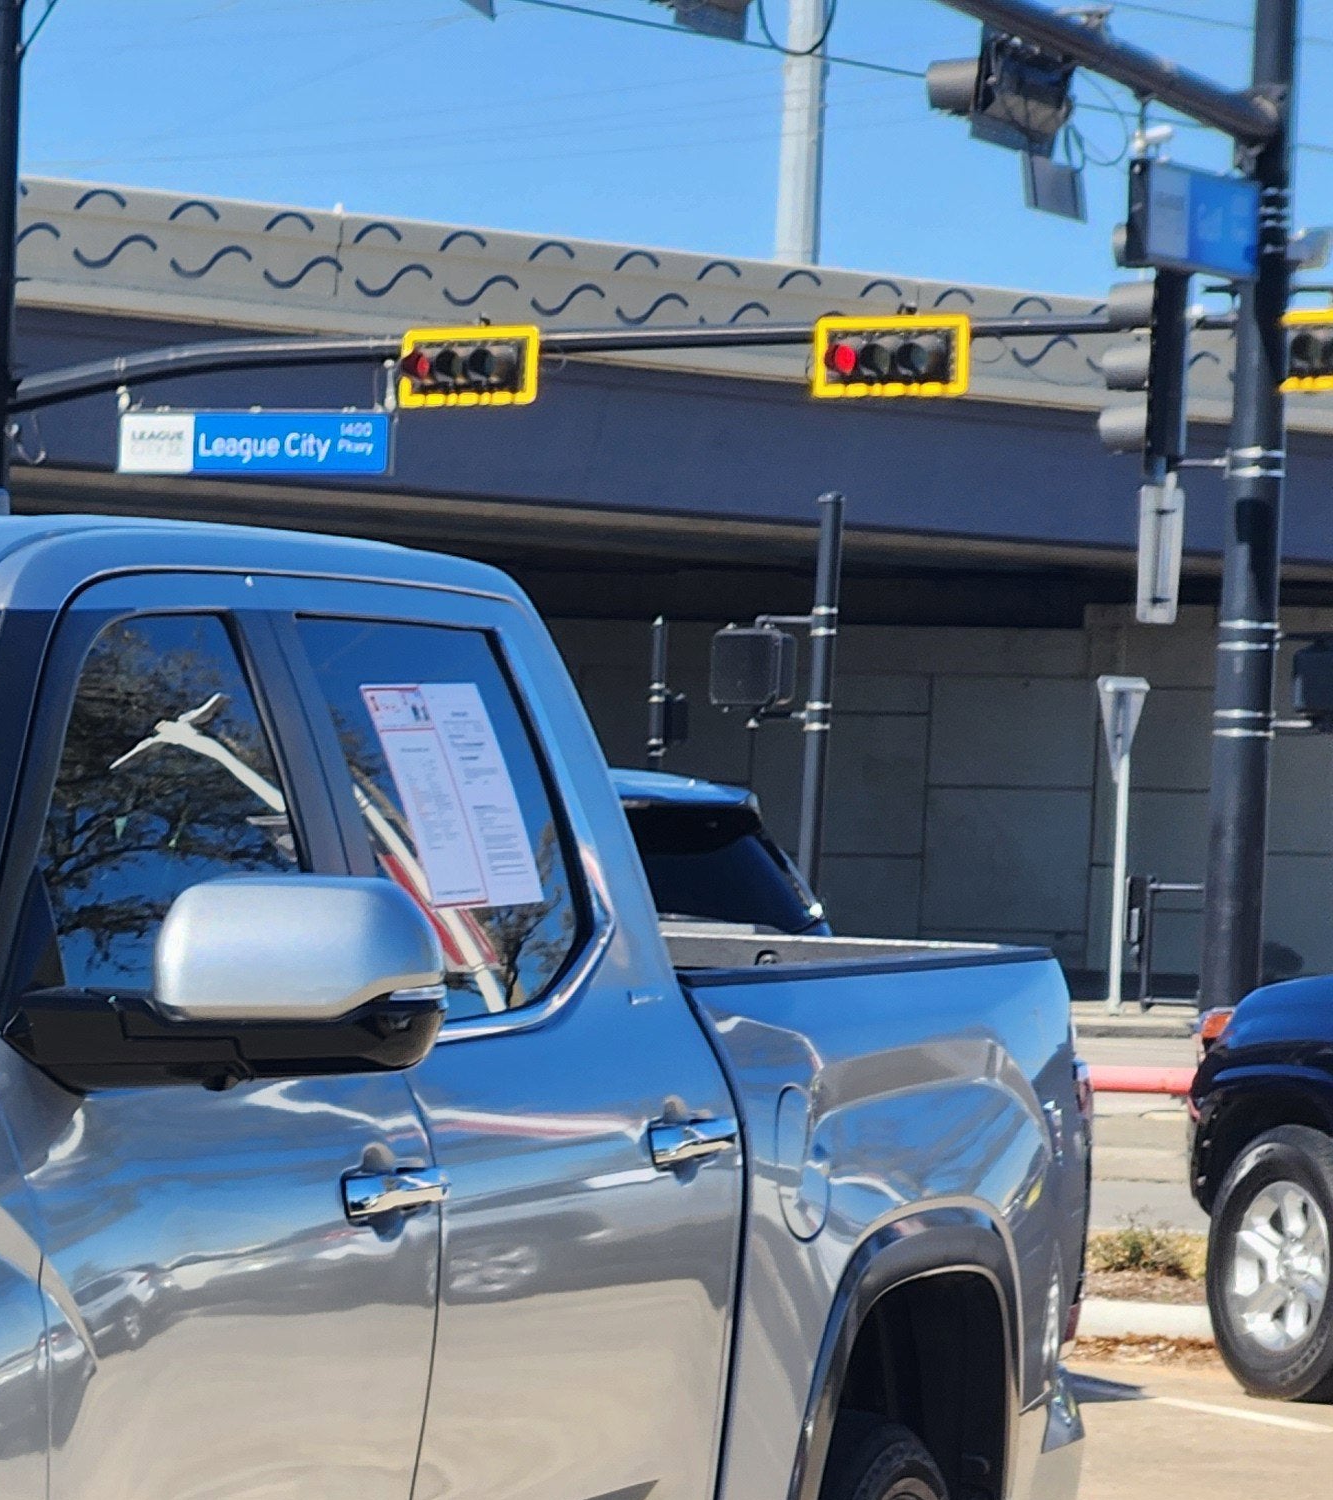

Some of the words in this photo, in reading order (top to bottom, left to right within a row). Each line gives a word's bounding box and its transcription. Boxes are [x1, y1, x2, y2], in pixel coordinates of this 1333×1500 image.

[131, 430, 185, 441] LEAGUE
[198, 433, 279, 464] League
[284, 432, 332, 463] City
